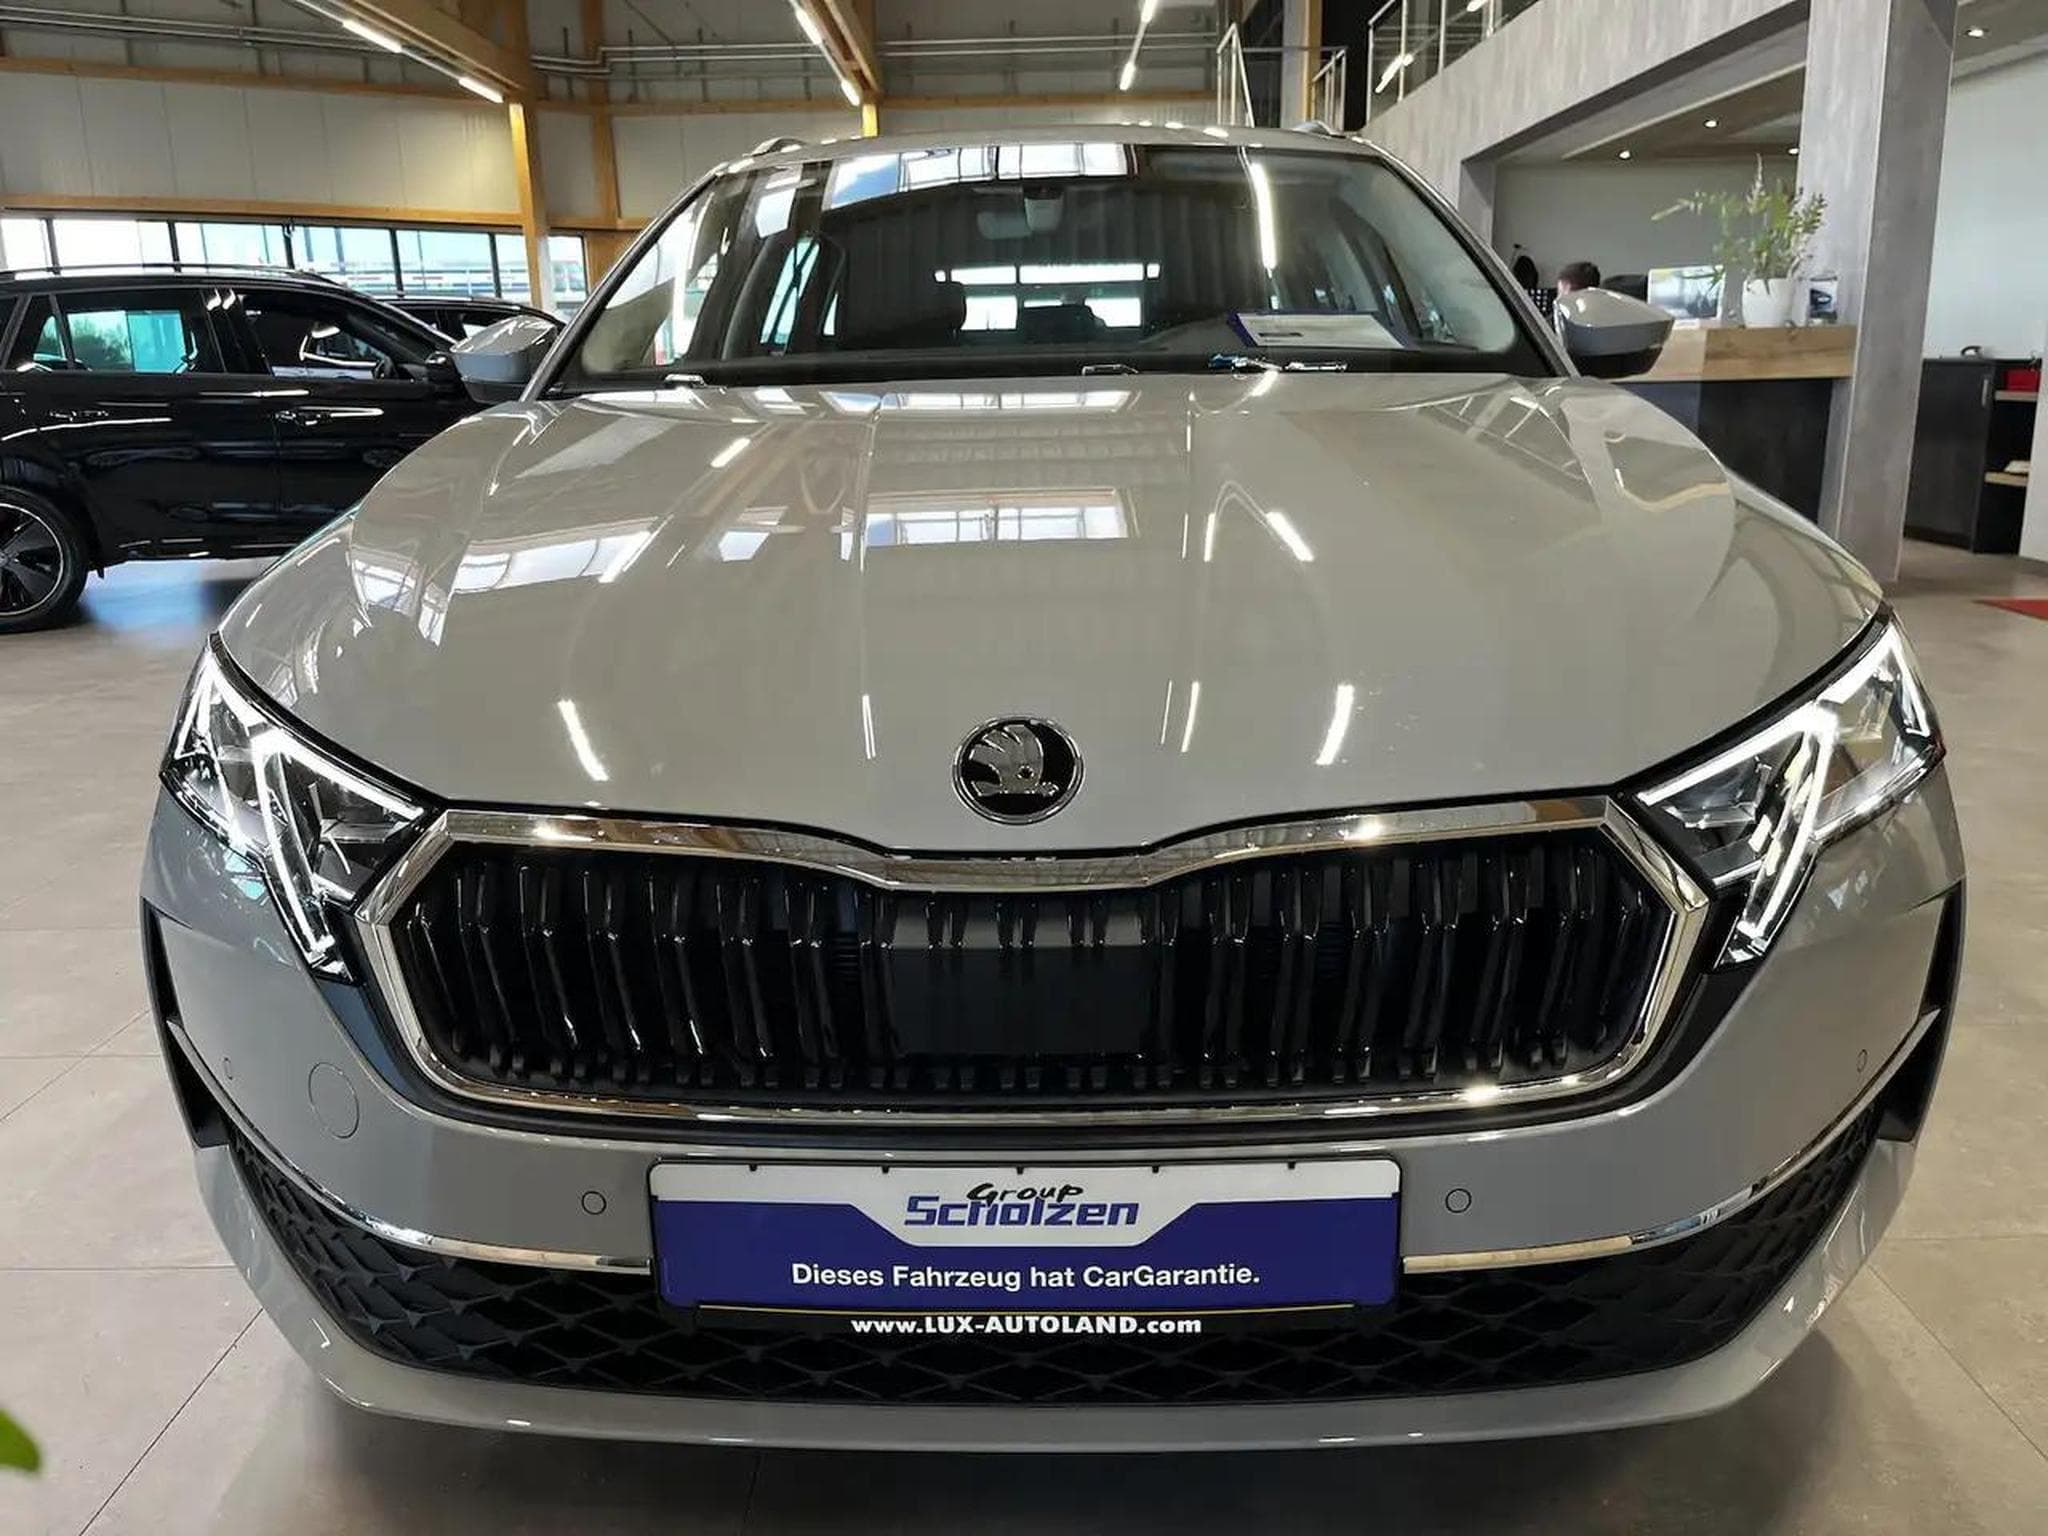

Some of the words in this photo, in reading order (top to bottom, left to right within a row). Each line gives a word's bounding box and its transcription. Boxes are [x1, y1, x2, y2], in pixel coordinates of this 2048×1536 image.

[967, 1183, 1083, 1206] Group
[904, 1196, 1139, 1225] Scholzen
[793, 1264, 883, 1285] Dieses
[894, 1266, 1020, 1291] Fahrzeug
[1031, 1267, 1075, 1287] hat
[1083, 1264, 1259, 1287] CarGarantie.
[851, 1316, 1201, 1333] www.LUX-AUTOLAND.com
